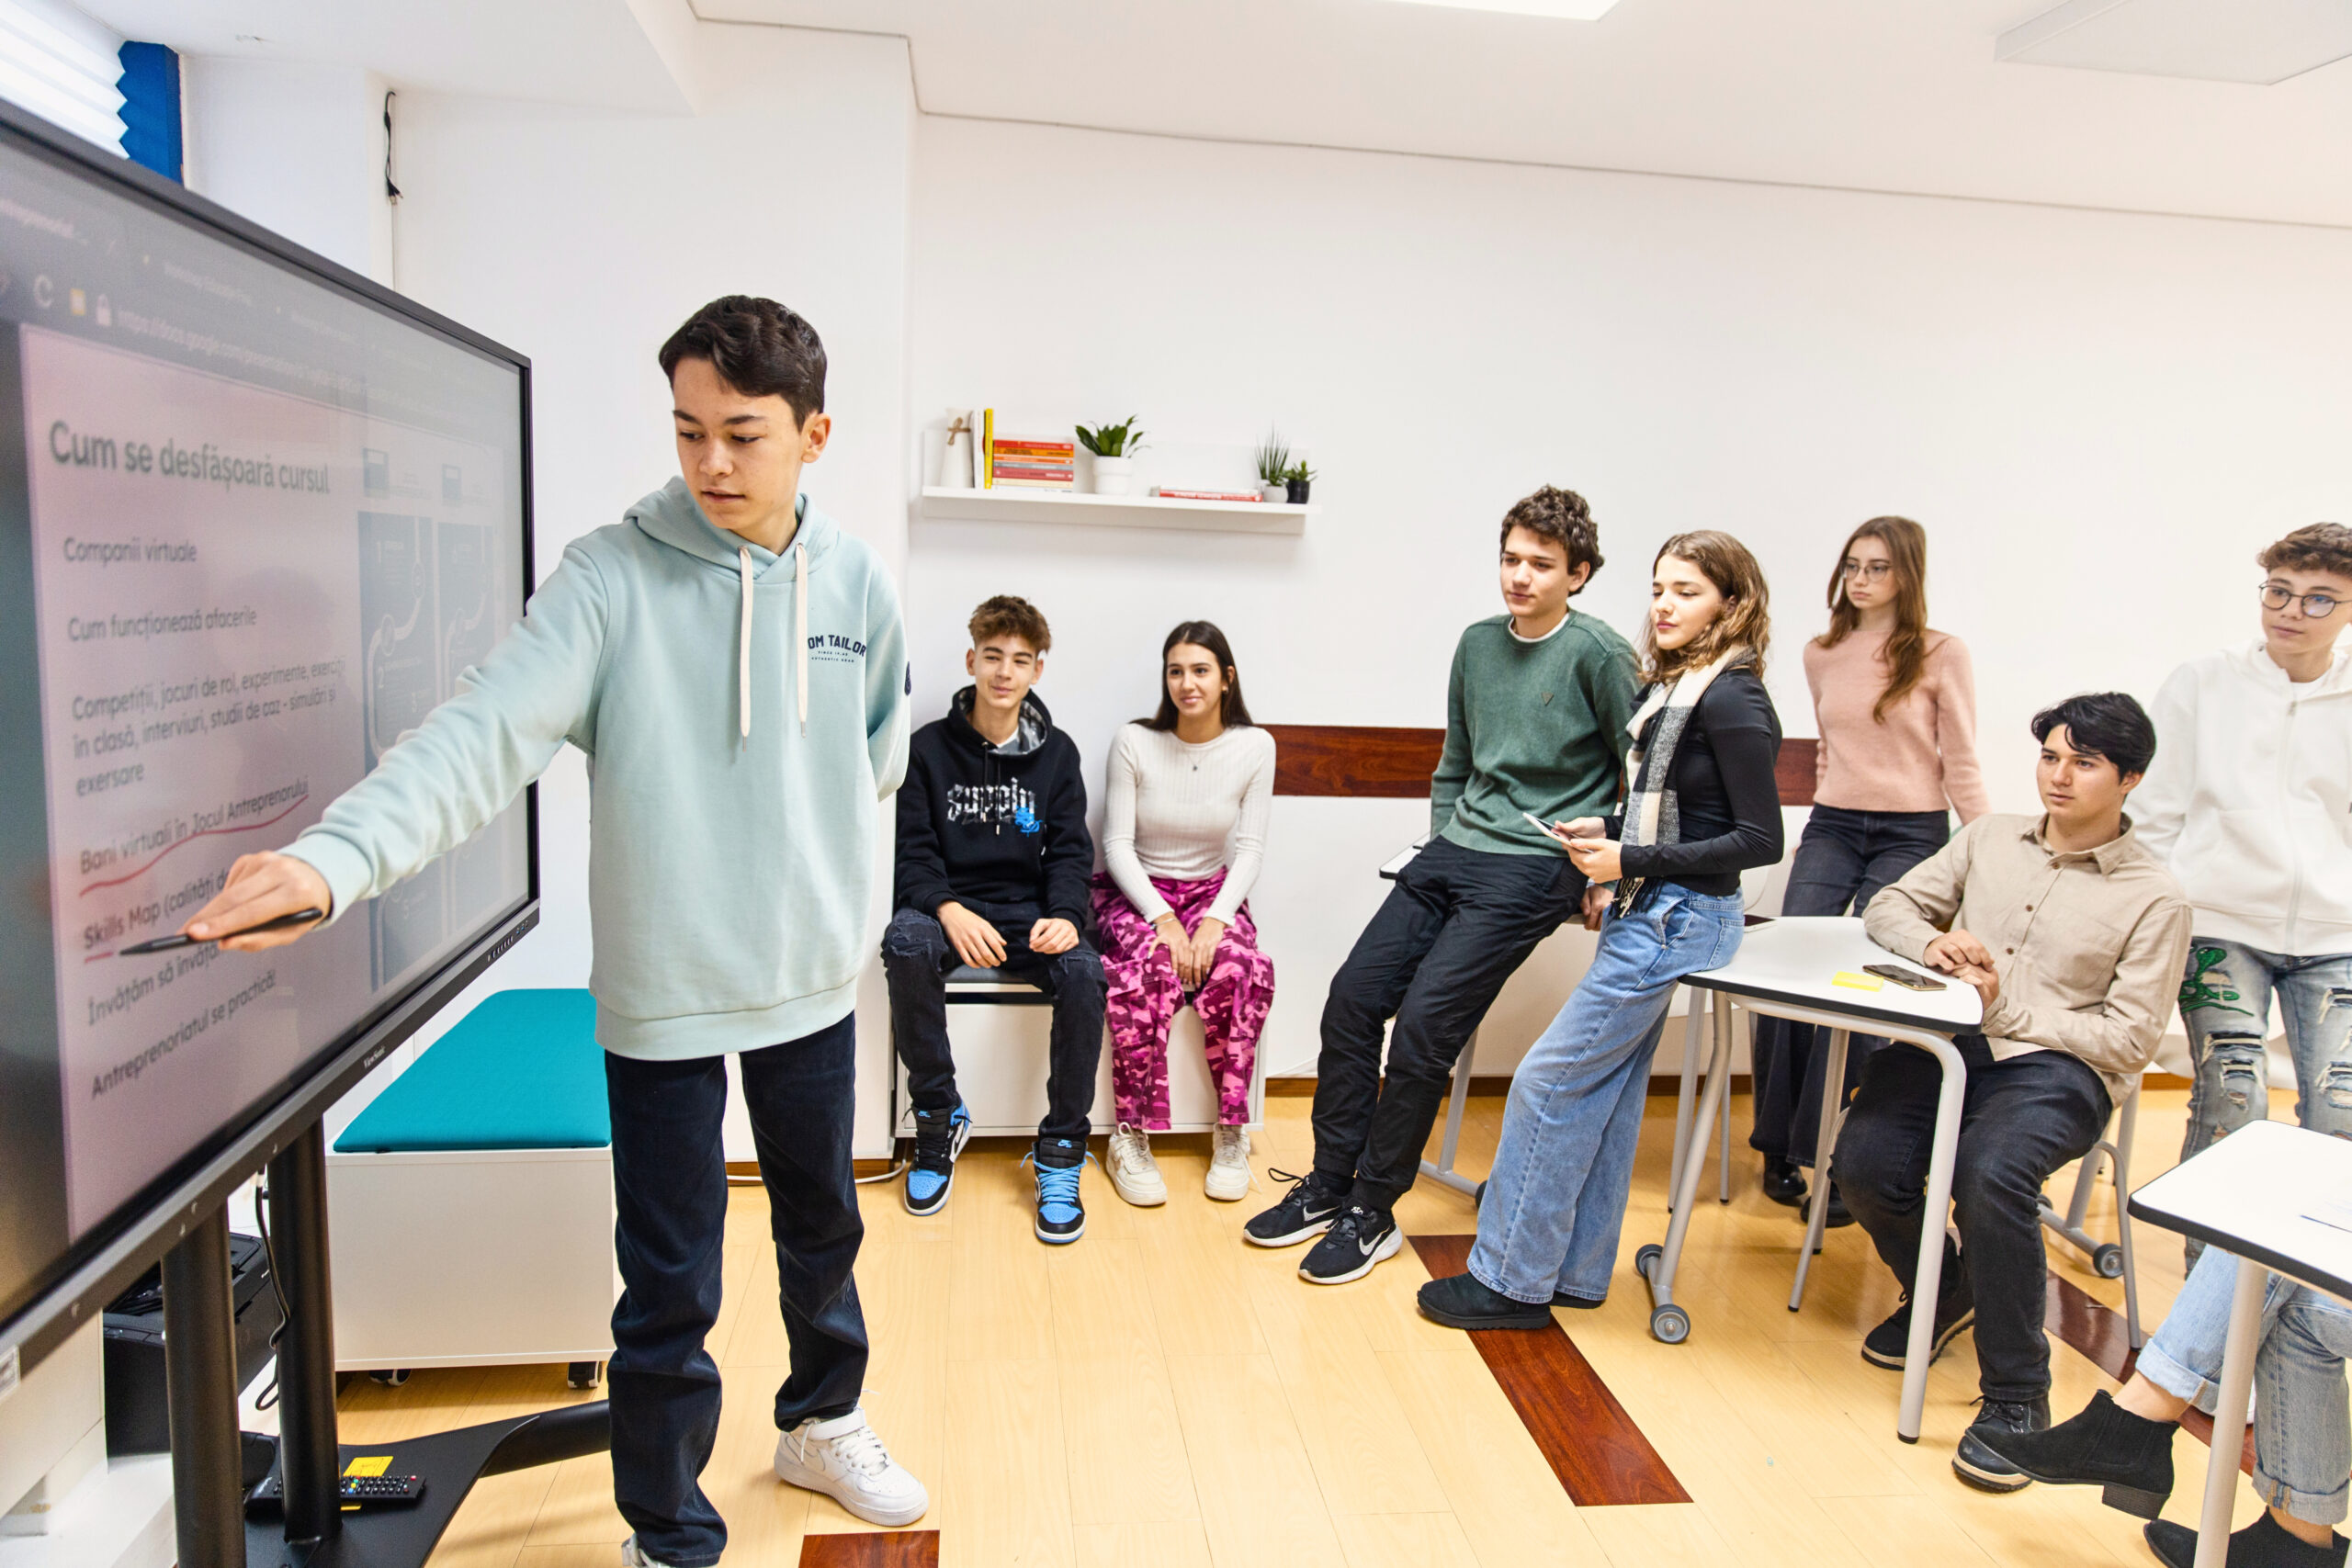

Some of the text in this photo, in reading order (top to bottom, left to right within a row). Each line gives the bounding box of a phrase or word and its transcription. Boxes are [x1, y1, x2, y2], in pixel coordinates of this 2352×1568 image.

[50, 420, 330, 493] Cum se desfășoară cursul
[63, 537, 197, 567] Companii virtuale
[67, 616, 106, 642] Cum
[205, 605, 256, 630] afacerile
[808, 635, 866, 657] OM TAILOR
[160, 677, 198, 710] jocuri
[202, 675, 217, 697] de
[211, 702, 243, 728] studii
[246, 701, 260, 720] de
[263, 700, 281, 716] caz
[76, 764, 144, 797] exersare
[80, 839, 117, 874] Bani
[121, 818, 172, 860] virtuali
[192, 803, 224, 835] Jocul
[85, 913, 124, 950] Skills
[129, 903, 160, 929] Map
[217, 867, 229, 890] d
[92, 1009, 209, 1100] Antreprenoriatul
[211, 1004, 225, 1025] se
